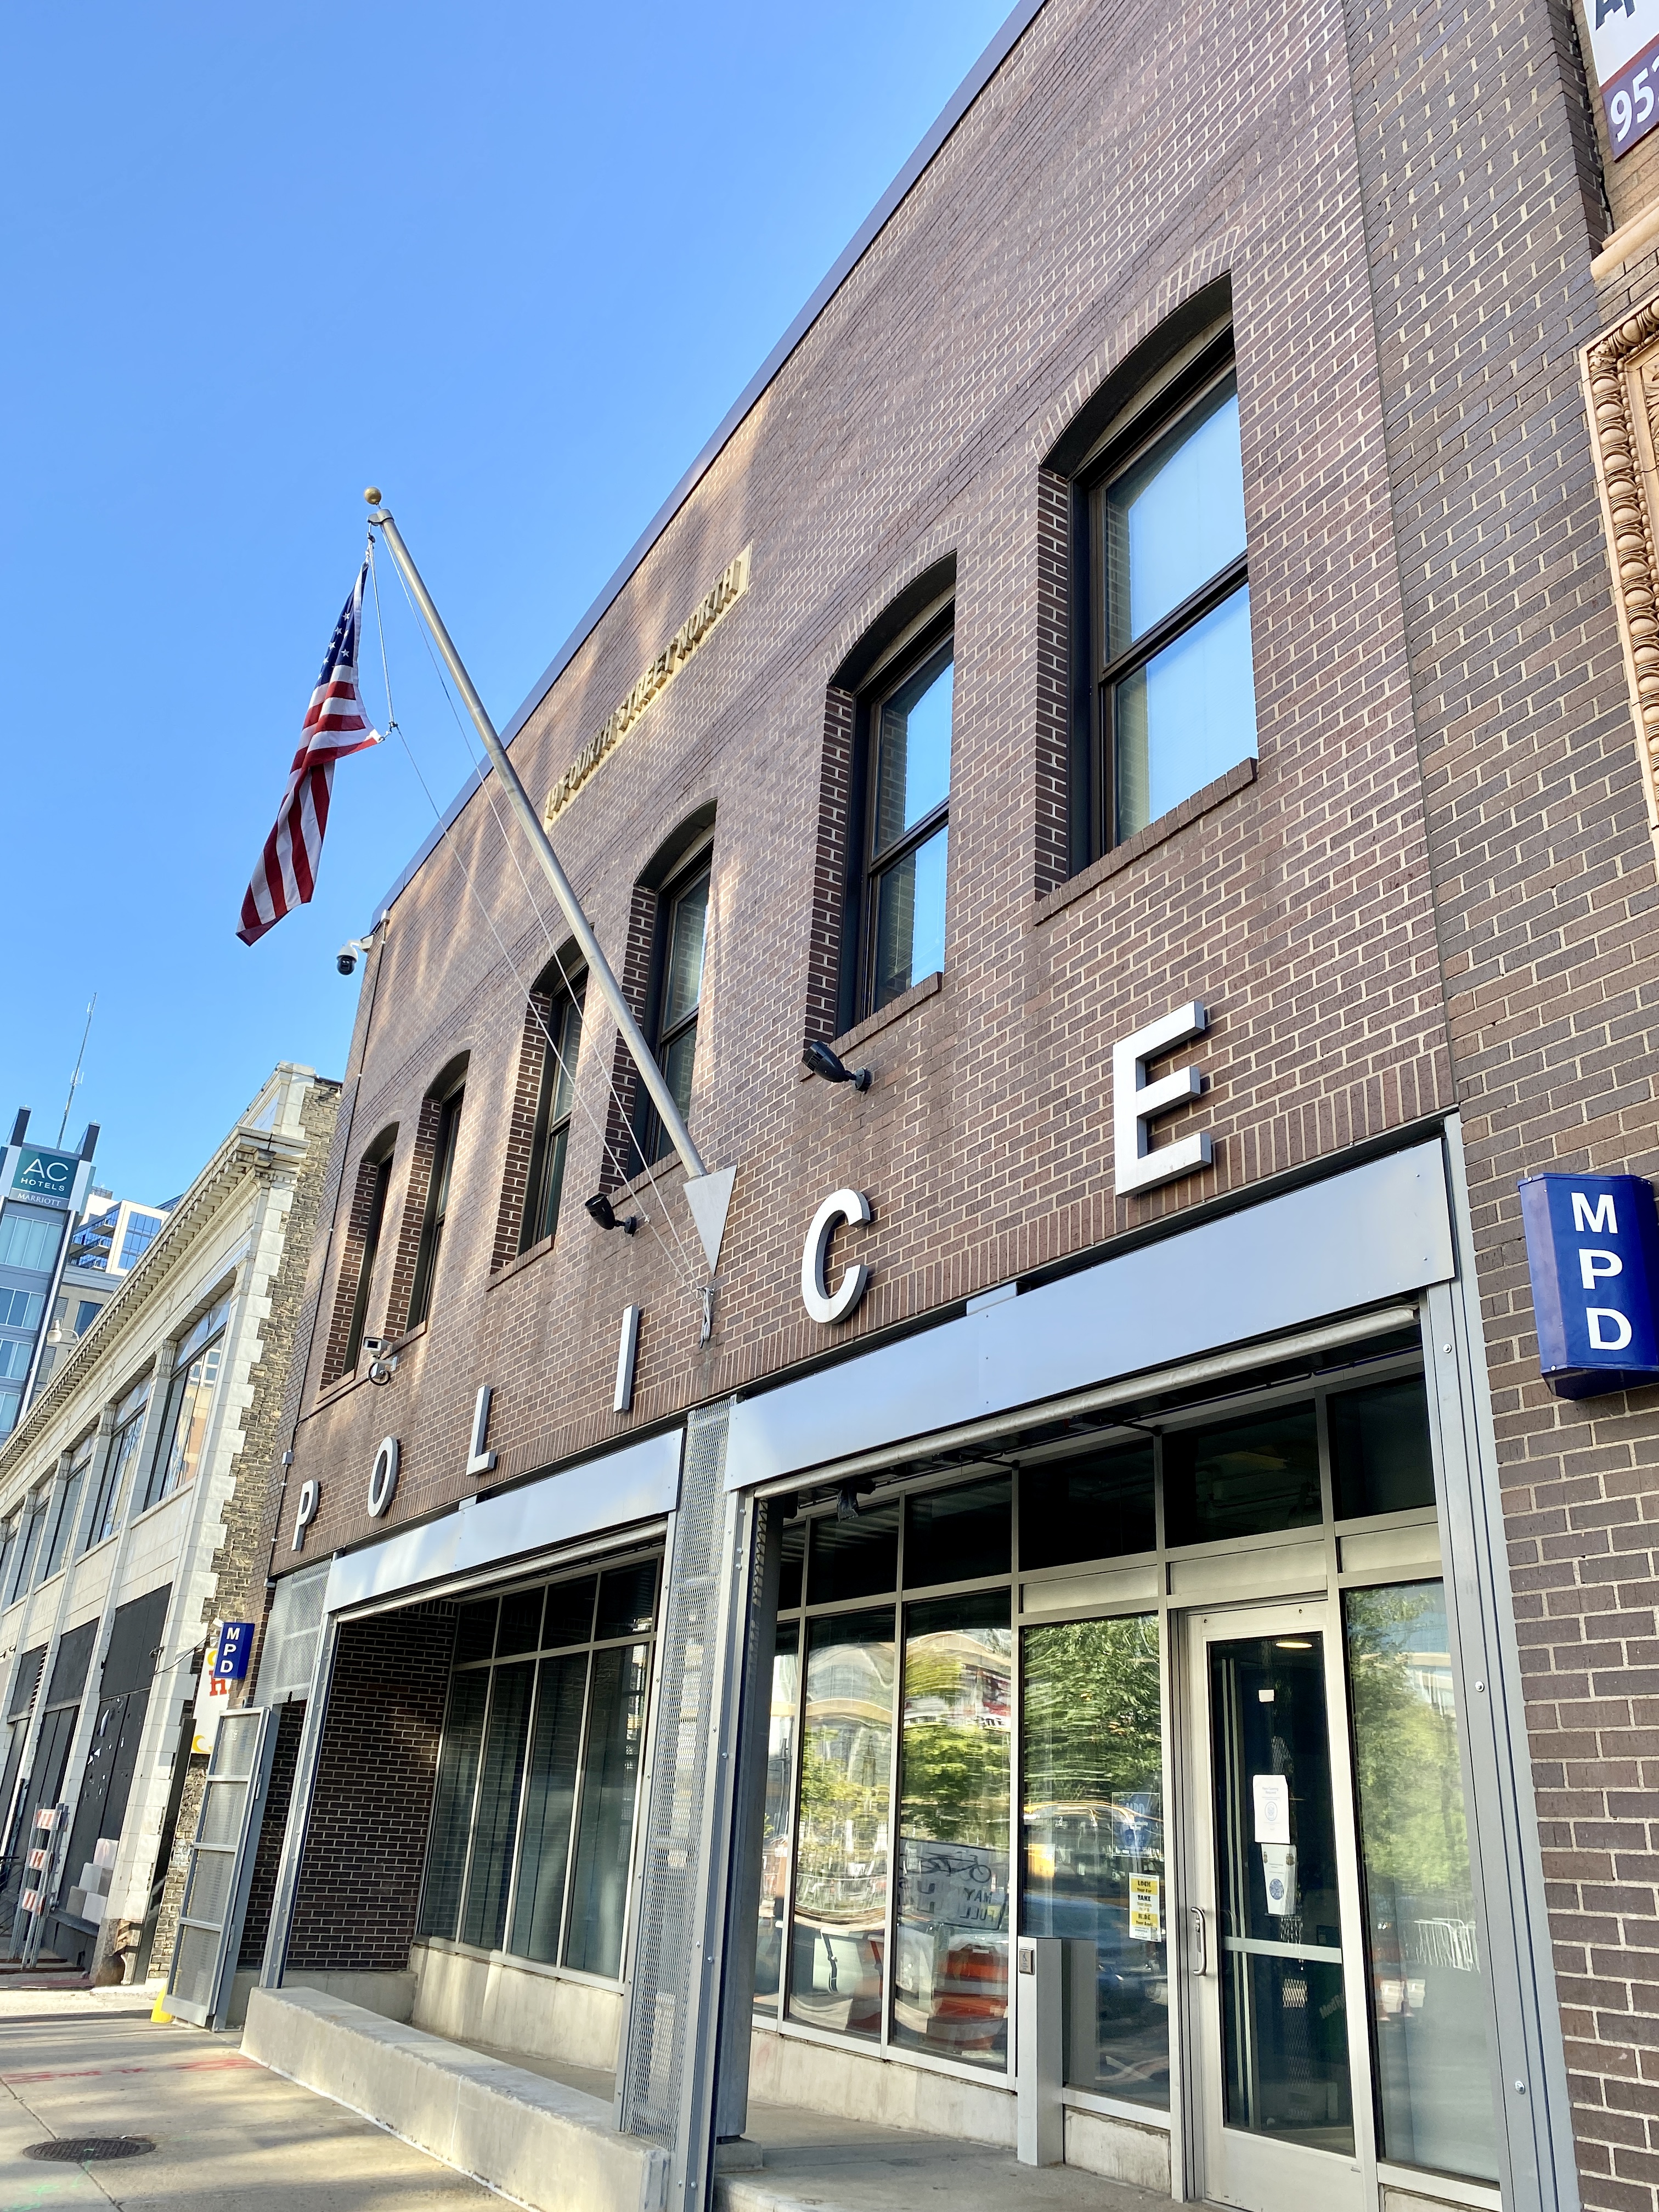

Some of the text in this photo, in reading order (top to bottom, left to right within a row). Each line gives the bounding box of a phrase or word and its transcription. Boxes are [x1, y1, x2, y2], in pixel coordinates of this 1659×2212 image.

[561, 712, 618, 802] FOURTH
[617, 636, 679, 732] STREET
[676, 559, 741, 660] NORTH
[20, 1177, 65, 1192] HOTELS
[23, 1158, 69, 1182] AC
[17, 1192, 62, 1207] MARRIOTT
[291, 1001, 1213, 1553] POLICE
[1571, 1192, 1632, 1351] MPD
[220, 1627, 240, 1673] MPD
